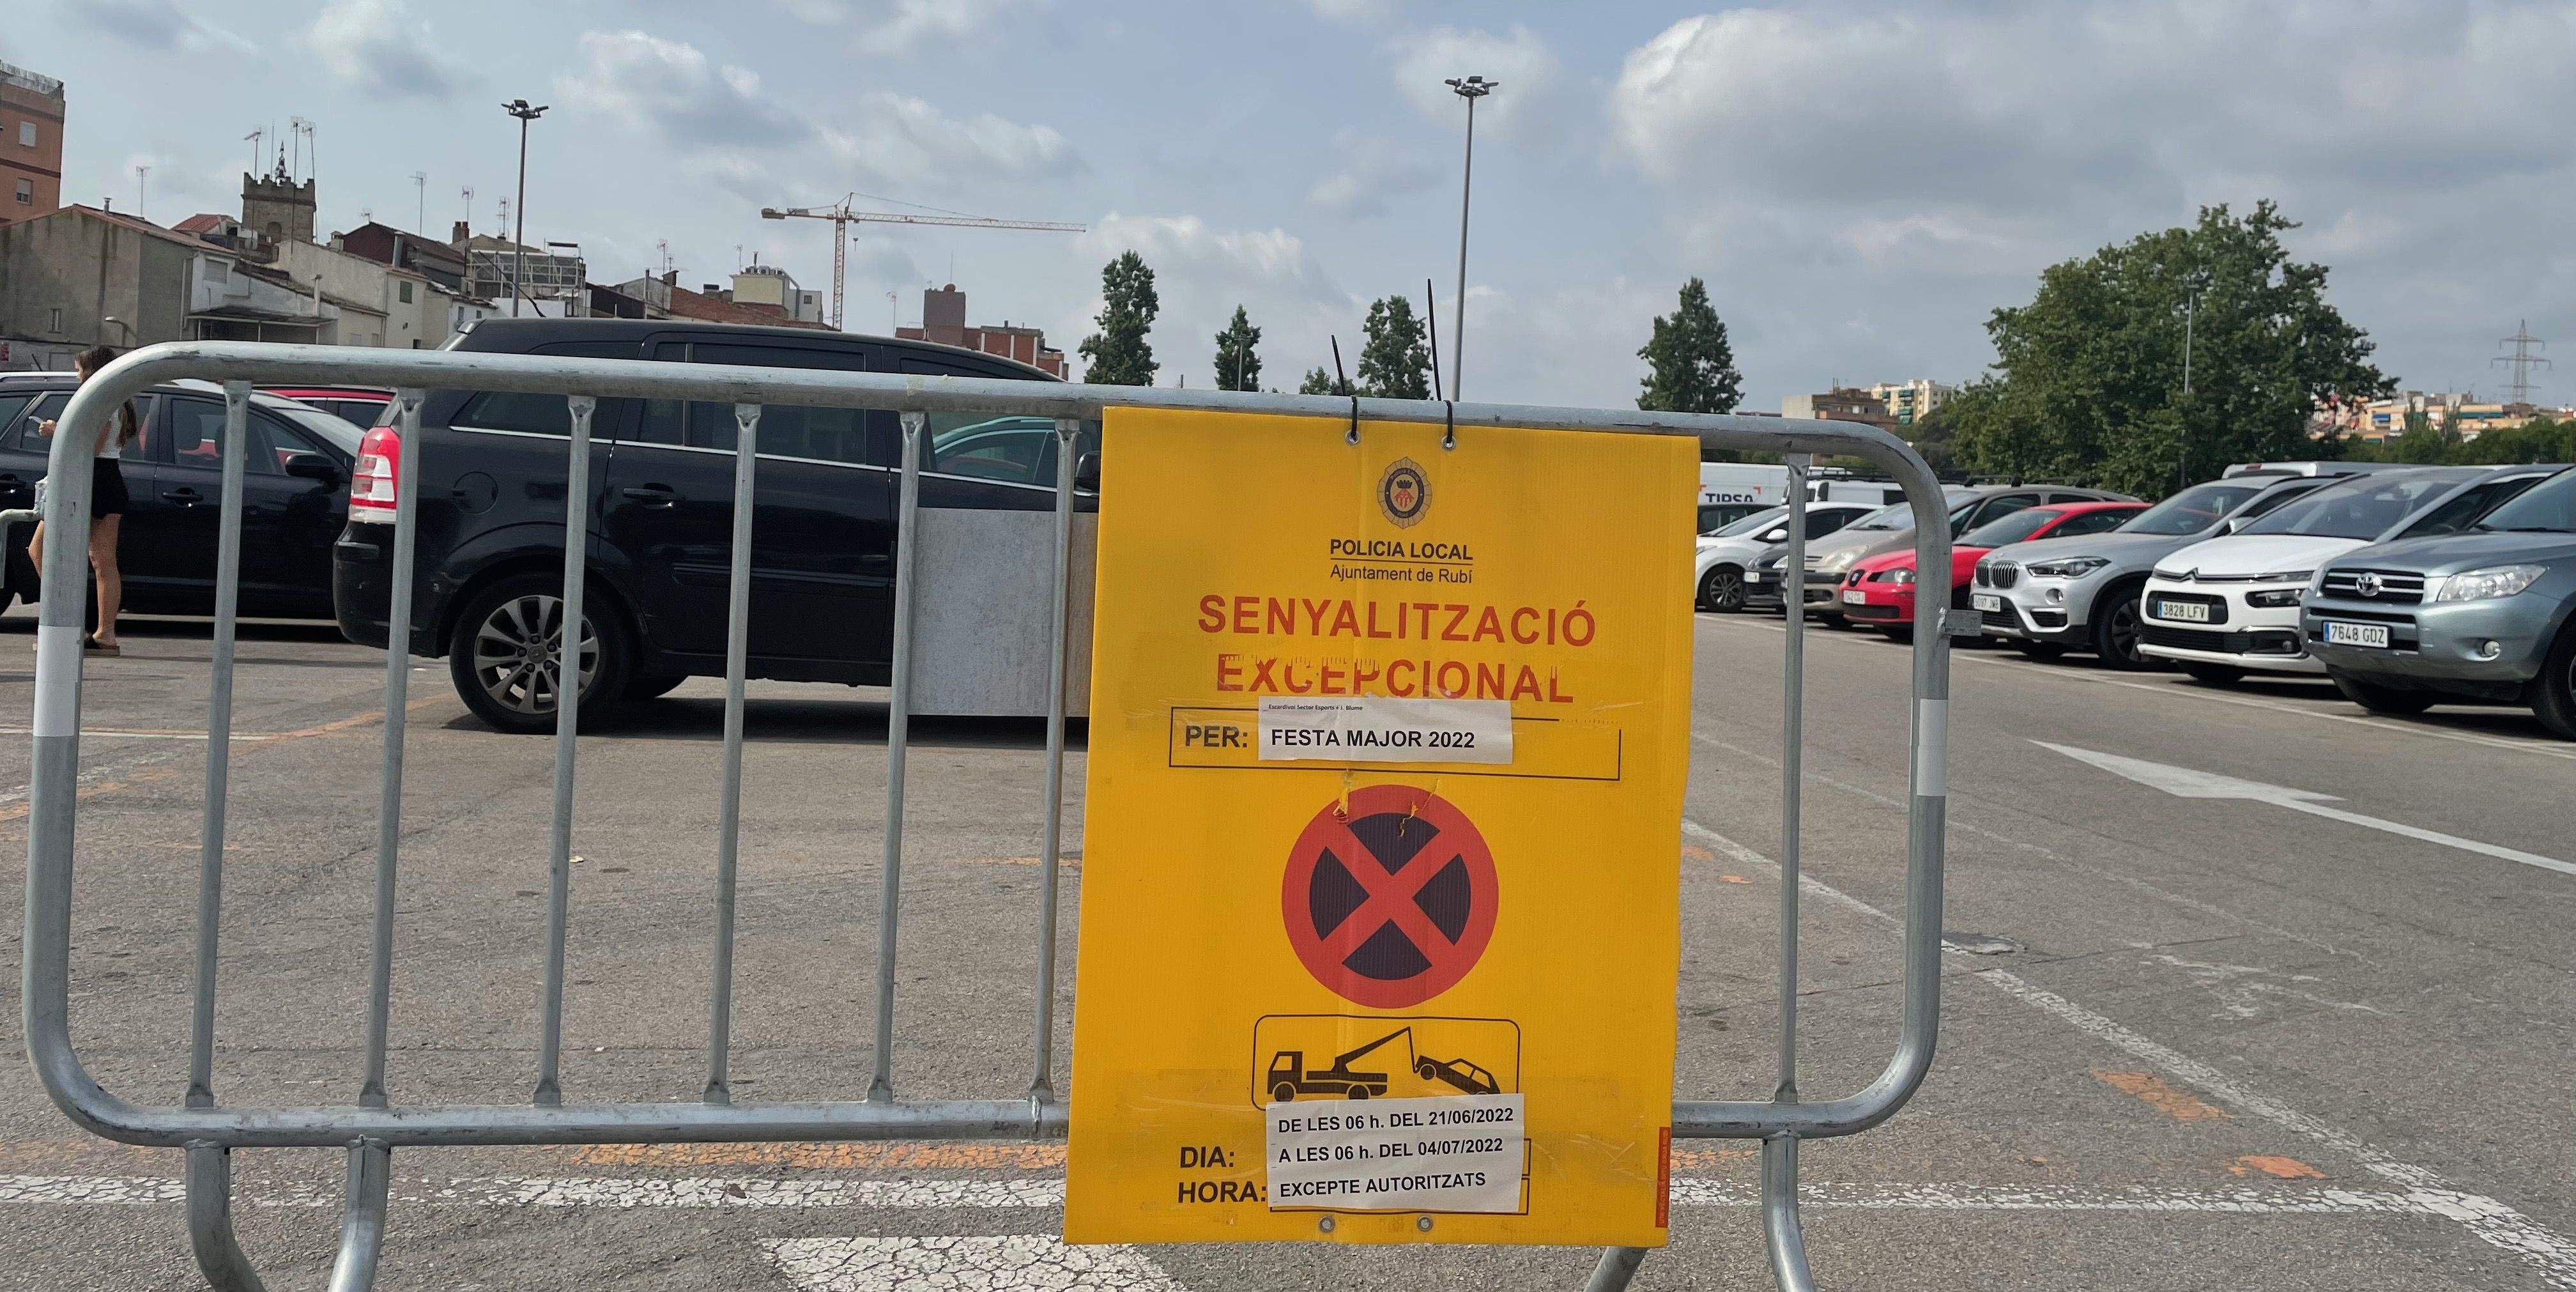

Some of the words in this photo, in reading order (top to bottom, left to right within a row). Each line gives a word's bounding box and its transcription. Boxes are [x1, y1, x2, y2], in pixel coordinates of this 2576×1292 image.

[1330, 539, 1405, 557] POLICIA
[1410, 542, 1473, 560] LOCAL
[1330, 564, 1412, 581] Ajuntament
[1416, 567, 1434, 581] de
[1439, 568, 1473, 583] Rubí
[1198, 594, 1596, 647] SENYALITZACIÓ
[2163, 604, 2184, 617] 3828
[2187, 606, 2205, 618] LFV
[2331, 626, 2359, 641] 7648
[2363, 628, 2385, 644] GDZ
[1216, 653, 1574, 704] EXCEPCIONAL
[1185, 726, 1248, 748] PER:
[1271, 730, 1340, 746] FESTA
[1347, 730, 1422, 748] MAJOR
[1428, 732, 1475, 748] 2022
[1278, 1119, 1301, 1134] DE
[1307, 1117, 1340, 1132] LES
[1345, 1115, 1364, 1130] 06
[1370, 1114, 1384, 1128] h.
[1390, 1112, 1423, 1127] DEL
[1429, 1107, 1514, 1125] 21/06/2022
[1180, 1146, 1234, 1167] DIA:
[1278, 1149, 1291, 1162] A
[1297, 1147, 1329, 1162] LES
[1335, 1145, 1354, 1160] 06
[1360, 1144, 1374, 1158] h.
[1379, 1142, 1413, 1157] DEL
[1418, 1137, 1503, 1155] 04/07/2022
[1178, 1181, 1266, 1203] HORA:
[1280, 1180, 1360, 1197] EXCEPTE
[1365, 1172, 1486, 1194] AUTORITZATS
